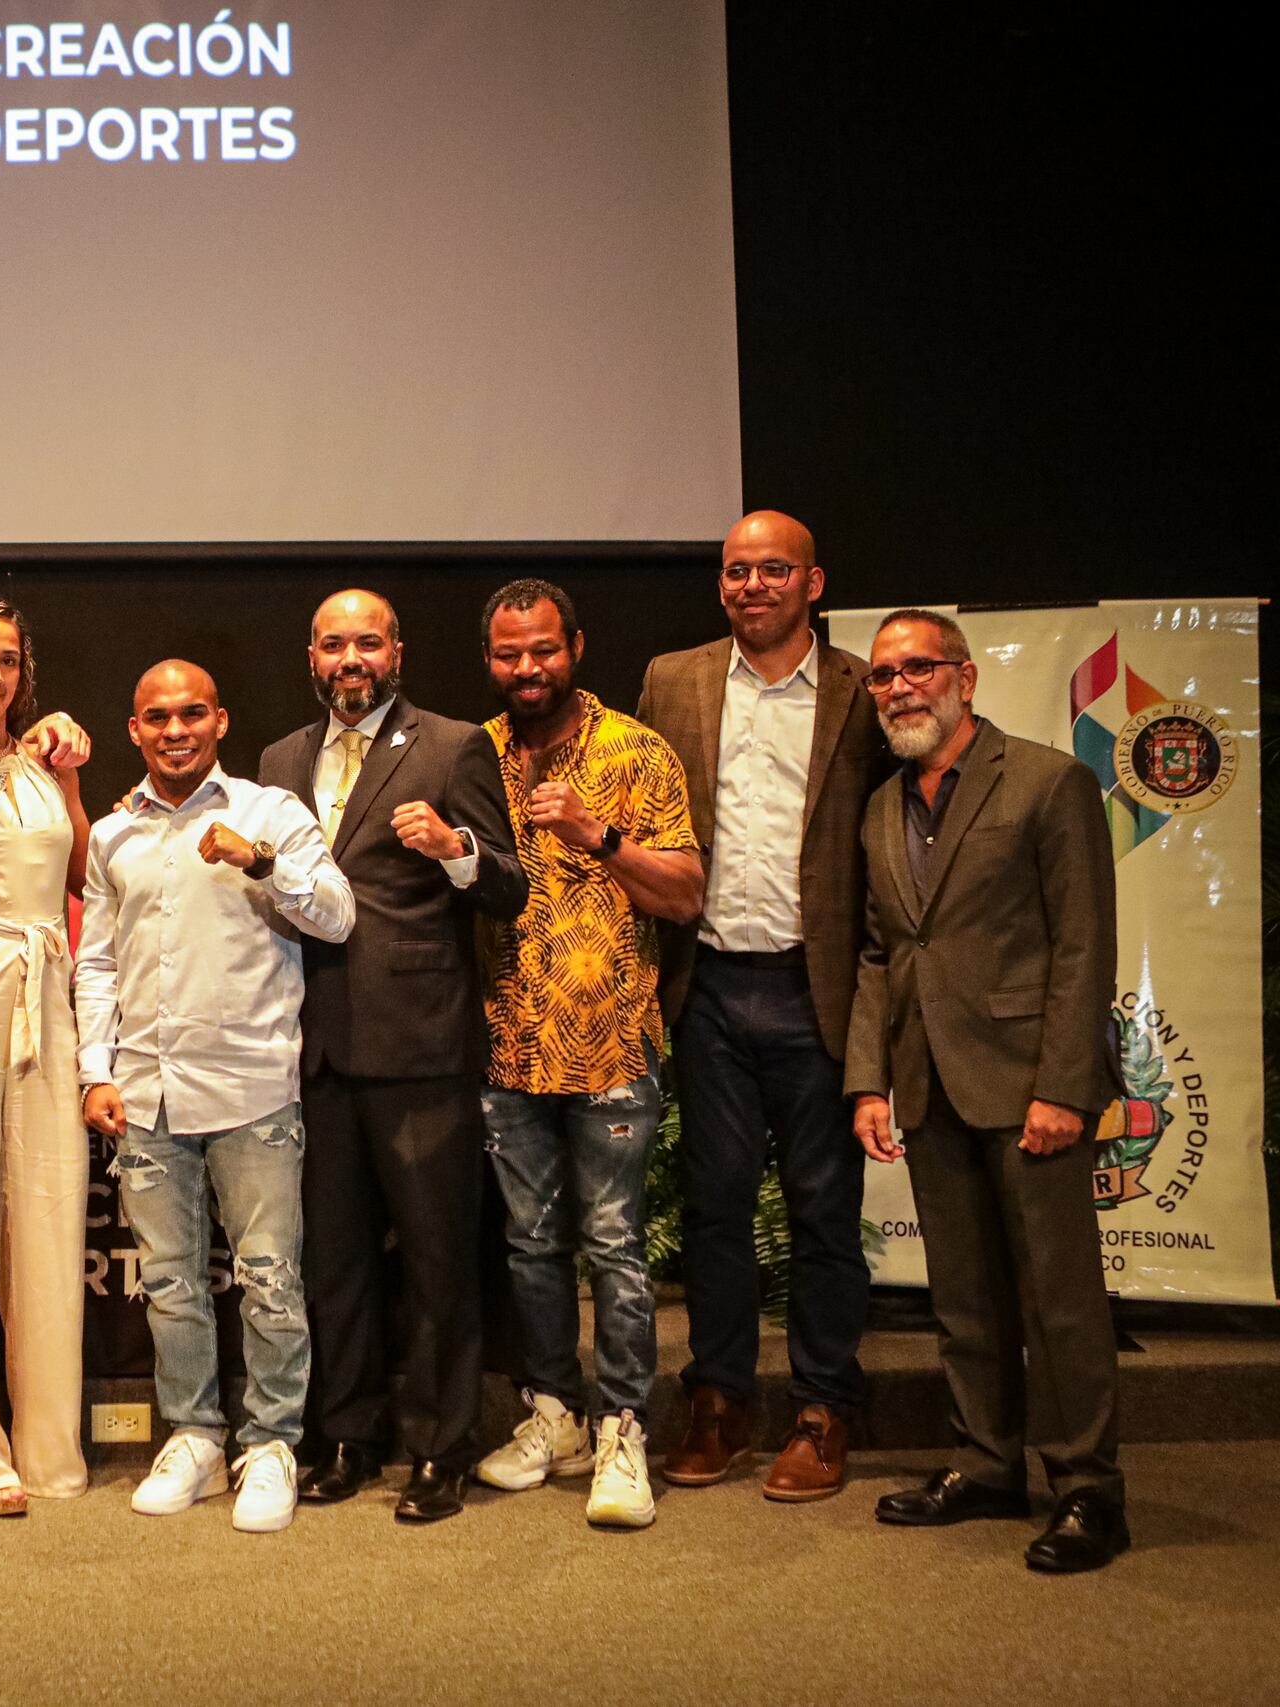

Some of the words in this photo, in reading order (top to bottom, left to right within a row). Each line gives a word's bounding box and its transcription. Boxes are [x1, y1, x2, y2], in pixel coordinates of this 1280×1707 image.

[1118, 714, 1149, 798] GOBIERNO
[1172, 703, 1233, 748] PUERTO
[1209, 754, 1235, 796] RICO
[1173, 1047, 1195, 1064] Y
[1154, 1073, 1210, 1215] DEPORTES
